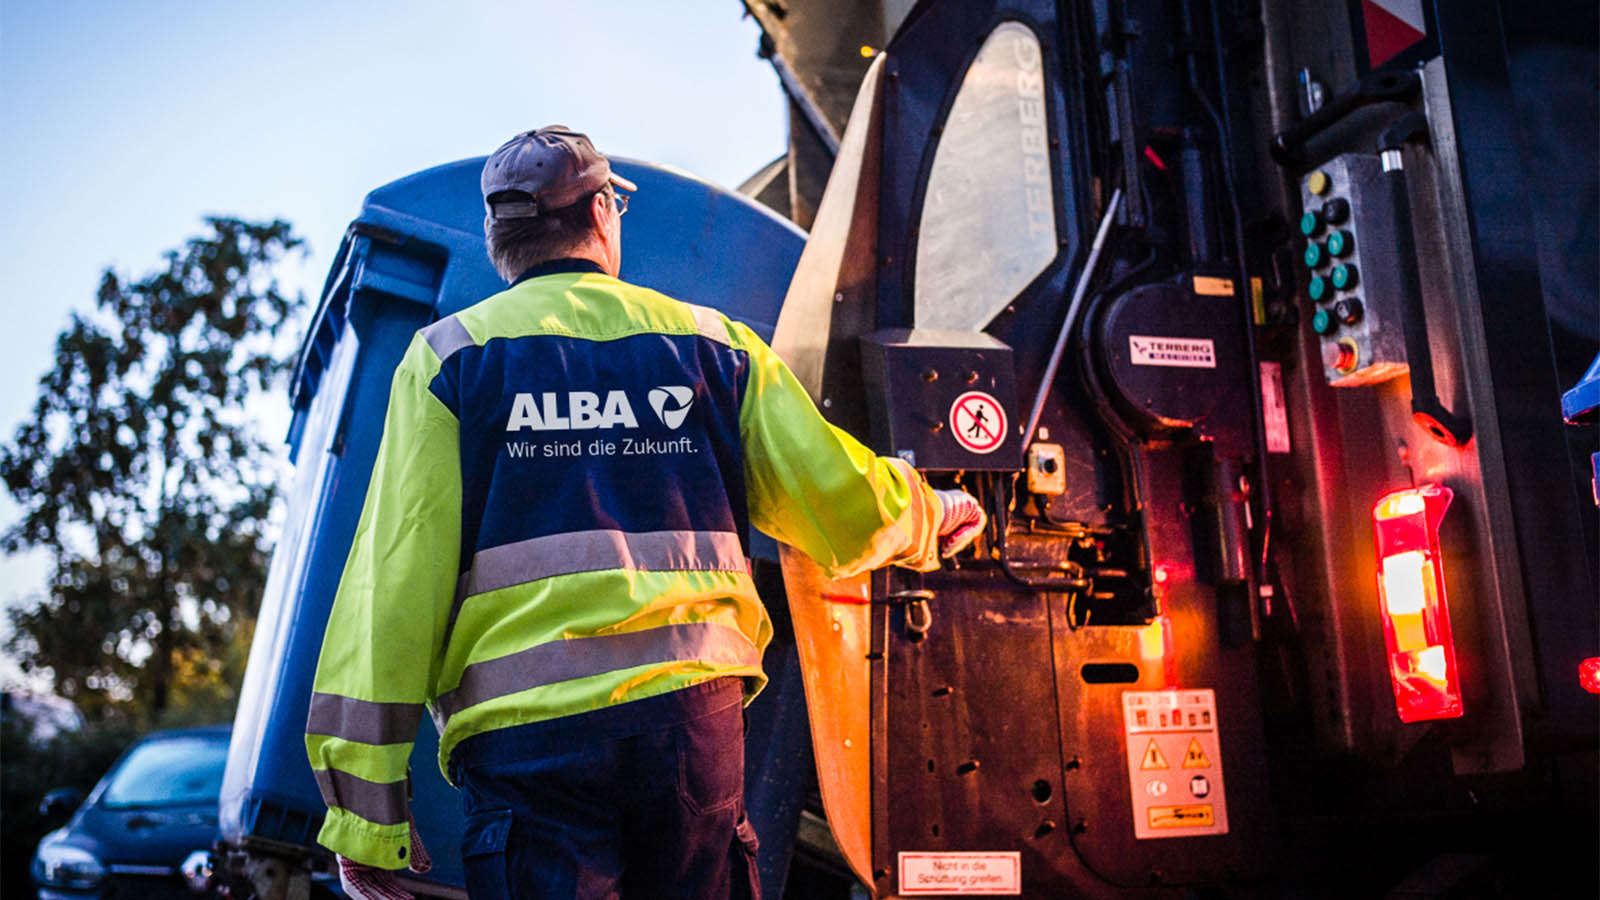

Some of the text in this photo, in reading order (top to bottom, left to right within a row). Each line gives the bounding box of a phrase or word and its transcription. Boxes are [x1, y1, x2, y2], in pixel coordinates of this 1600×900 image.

[1014, 37, 1047, 241] TERBERG
[1149, 342, 1211, 353] TERBERG
[506, 390, 639, 431] ALBA
[506, 437, 698, 458] Wir sind die Zukunft.
